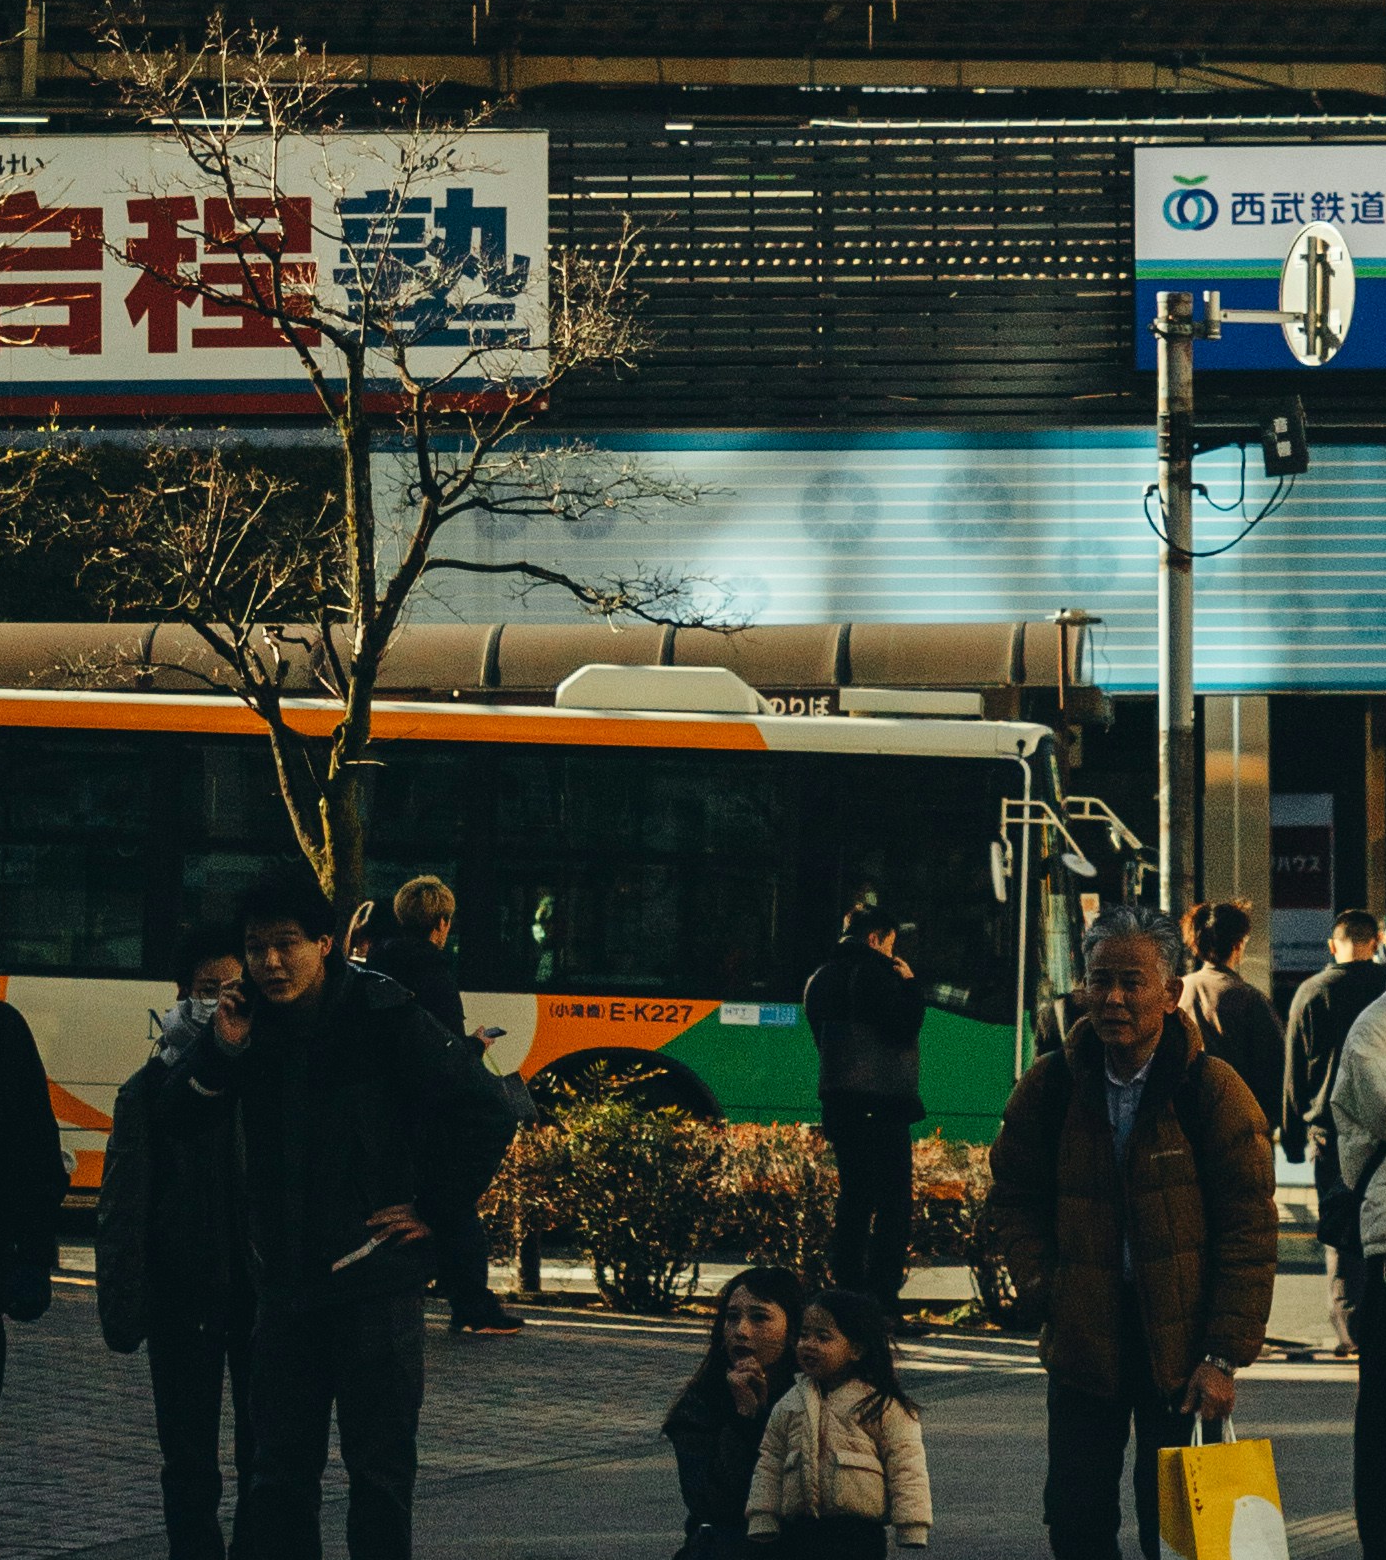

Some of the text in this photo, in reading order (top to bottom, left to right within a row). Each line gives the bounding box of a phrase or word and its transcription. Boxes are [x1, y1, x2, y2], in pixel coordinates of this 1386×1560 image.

[1231, 191, 1386, 226] 西武鉄道
[610, 1002, 694, 1024] E-K227
